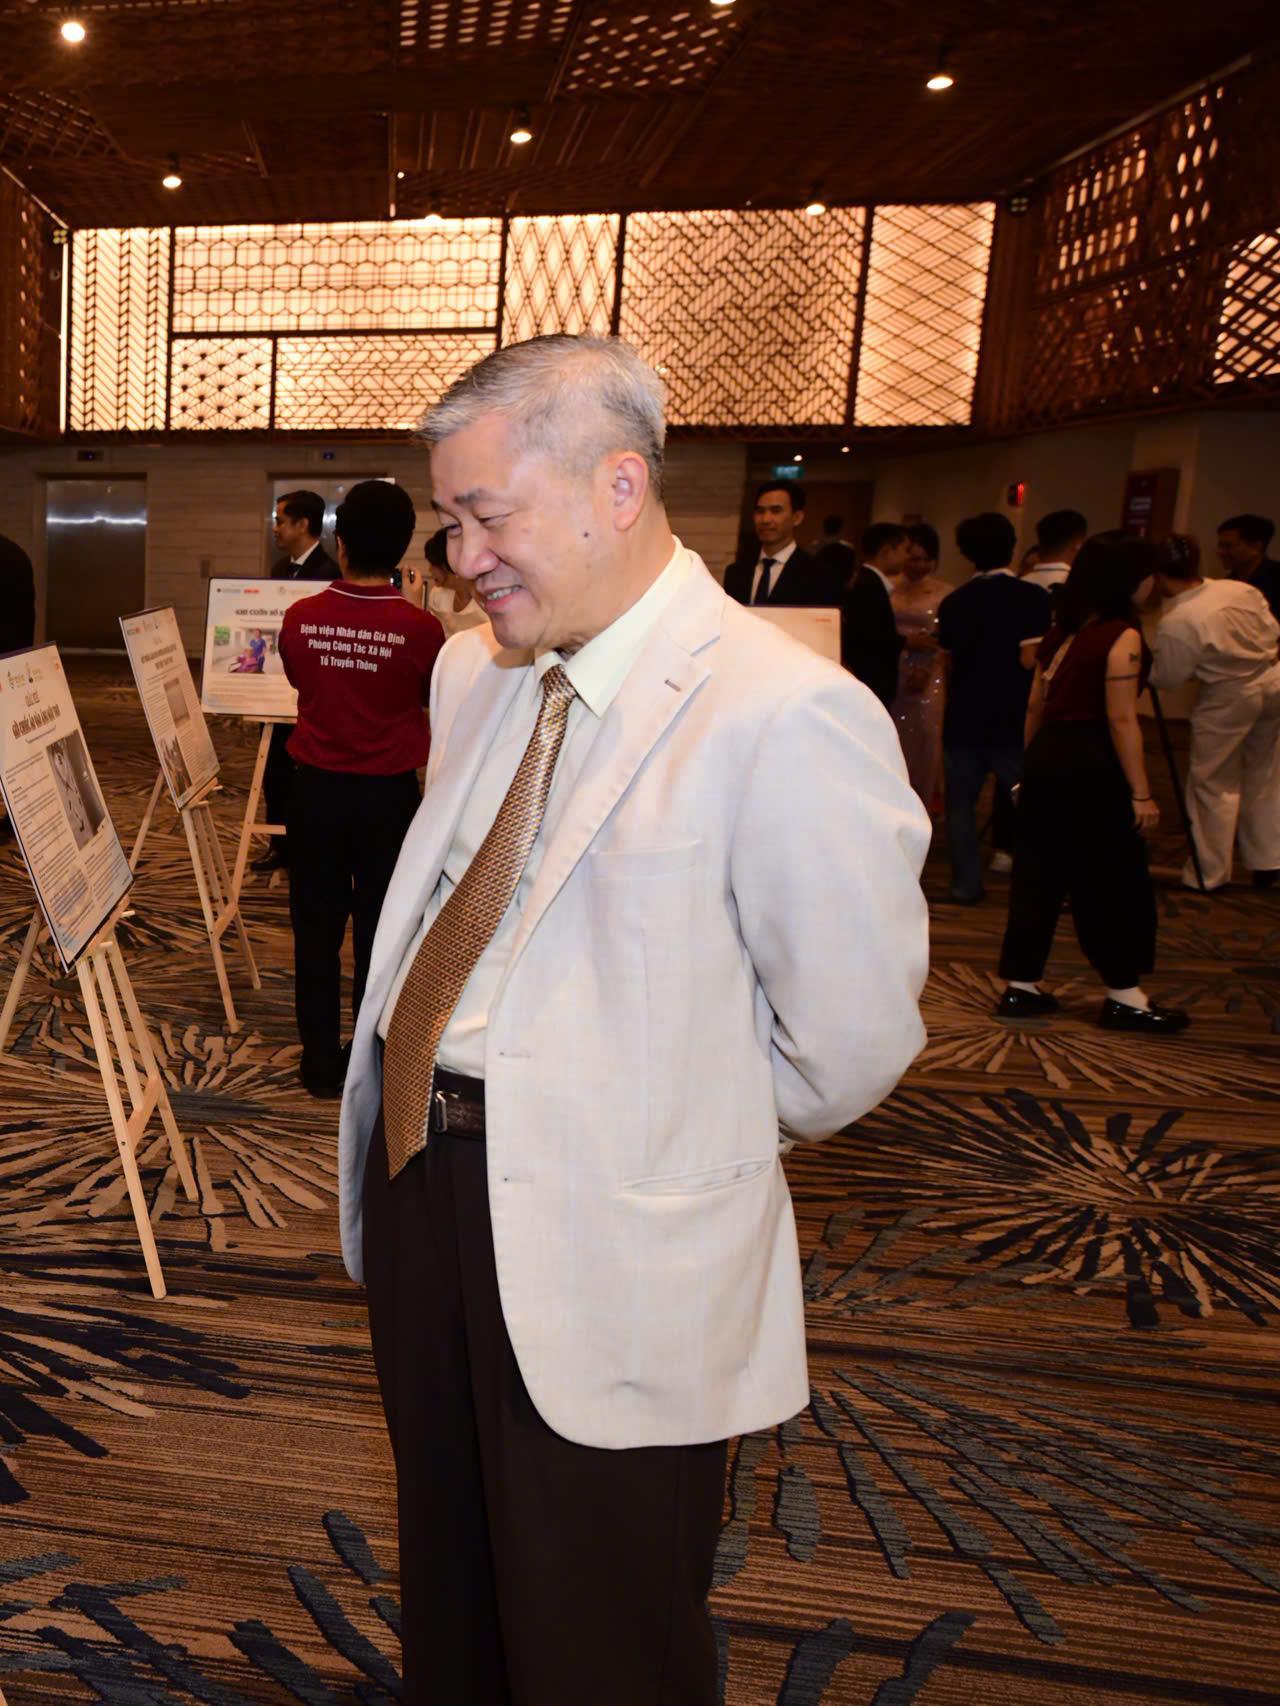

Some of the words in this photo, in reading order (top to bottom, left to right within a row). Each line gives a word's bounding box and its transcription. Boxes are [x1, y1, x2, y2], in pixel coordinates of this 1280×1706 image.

[300, 624, 317, 636] Bệnh
[318, 626, 334, 638] viện
[336, 626, 355, 638] Nhân
[357, 628, 372, 640] dân
[373, 631, 386, 642] Gia
[387, 633, 405, 646] Định
[308, 639, 331, 651] Phòng
[332, 640, 351, 654] Công
[353, 642, 366, 655] Tác
[379, 646, 392, 659] Hội
[330, 655, 354, 669] Truyền
[356, 659, 378, 673] Thông
